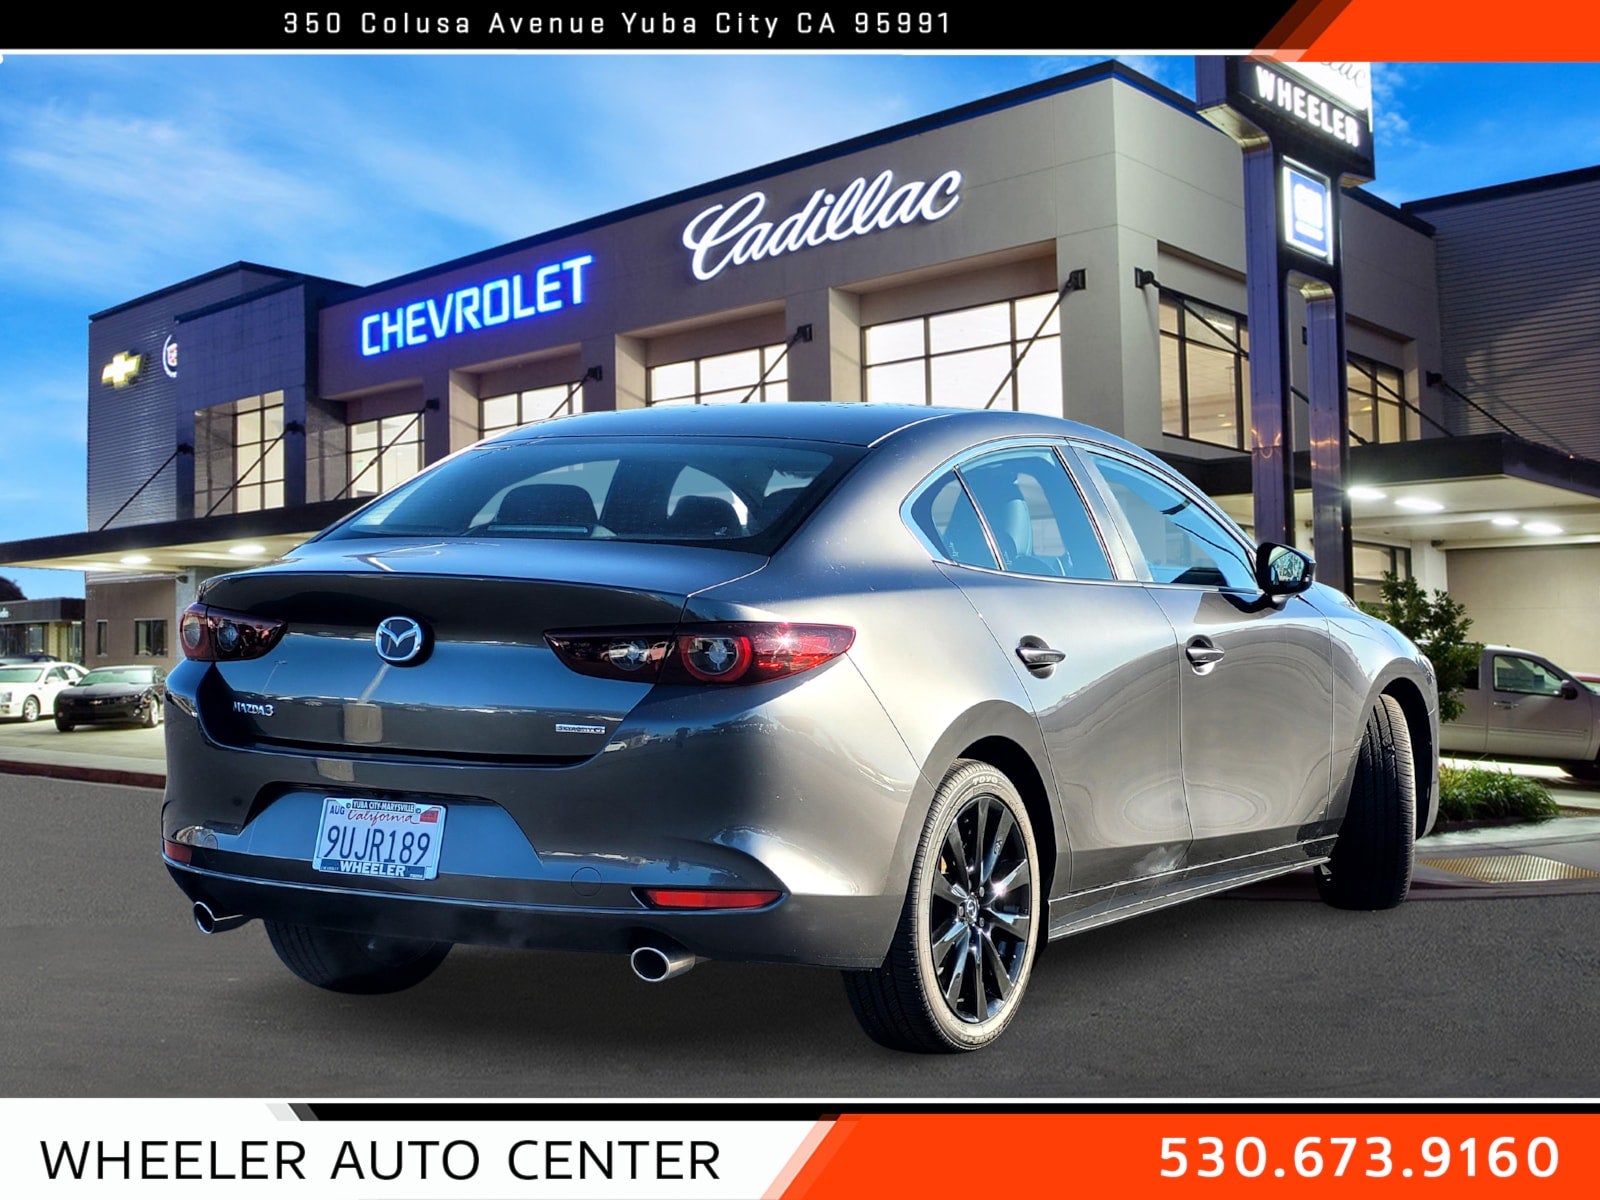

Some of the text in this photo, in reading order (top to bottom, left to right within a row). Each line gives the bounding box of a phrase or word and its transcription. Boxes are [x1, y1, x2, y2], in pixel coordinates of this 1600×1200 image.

[1255, 64, 1359, 148] WHEELER
[683, 169, 963, 281] Cadillac
[361, 254, 594, 357] CHEVROLET
[973, 775, 998, 785] TOYO
[330, 804, 345, 815] AUG
[347, 809, 420, 827] California
[323, 825, 431, 865] 9UJR189
[340, 860, 406, 877] WHEELER
